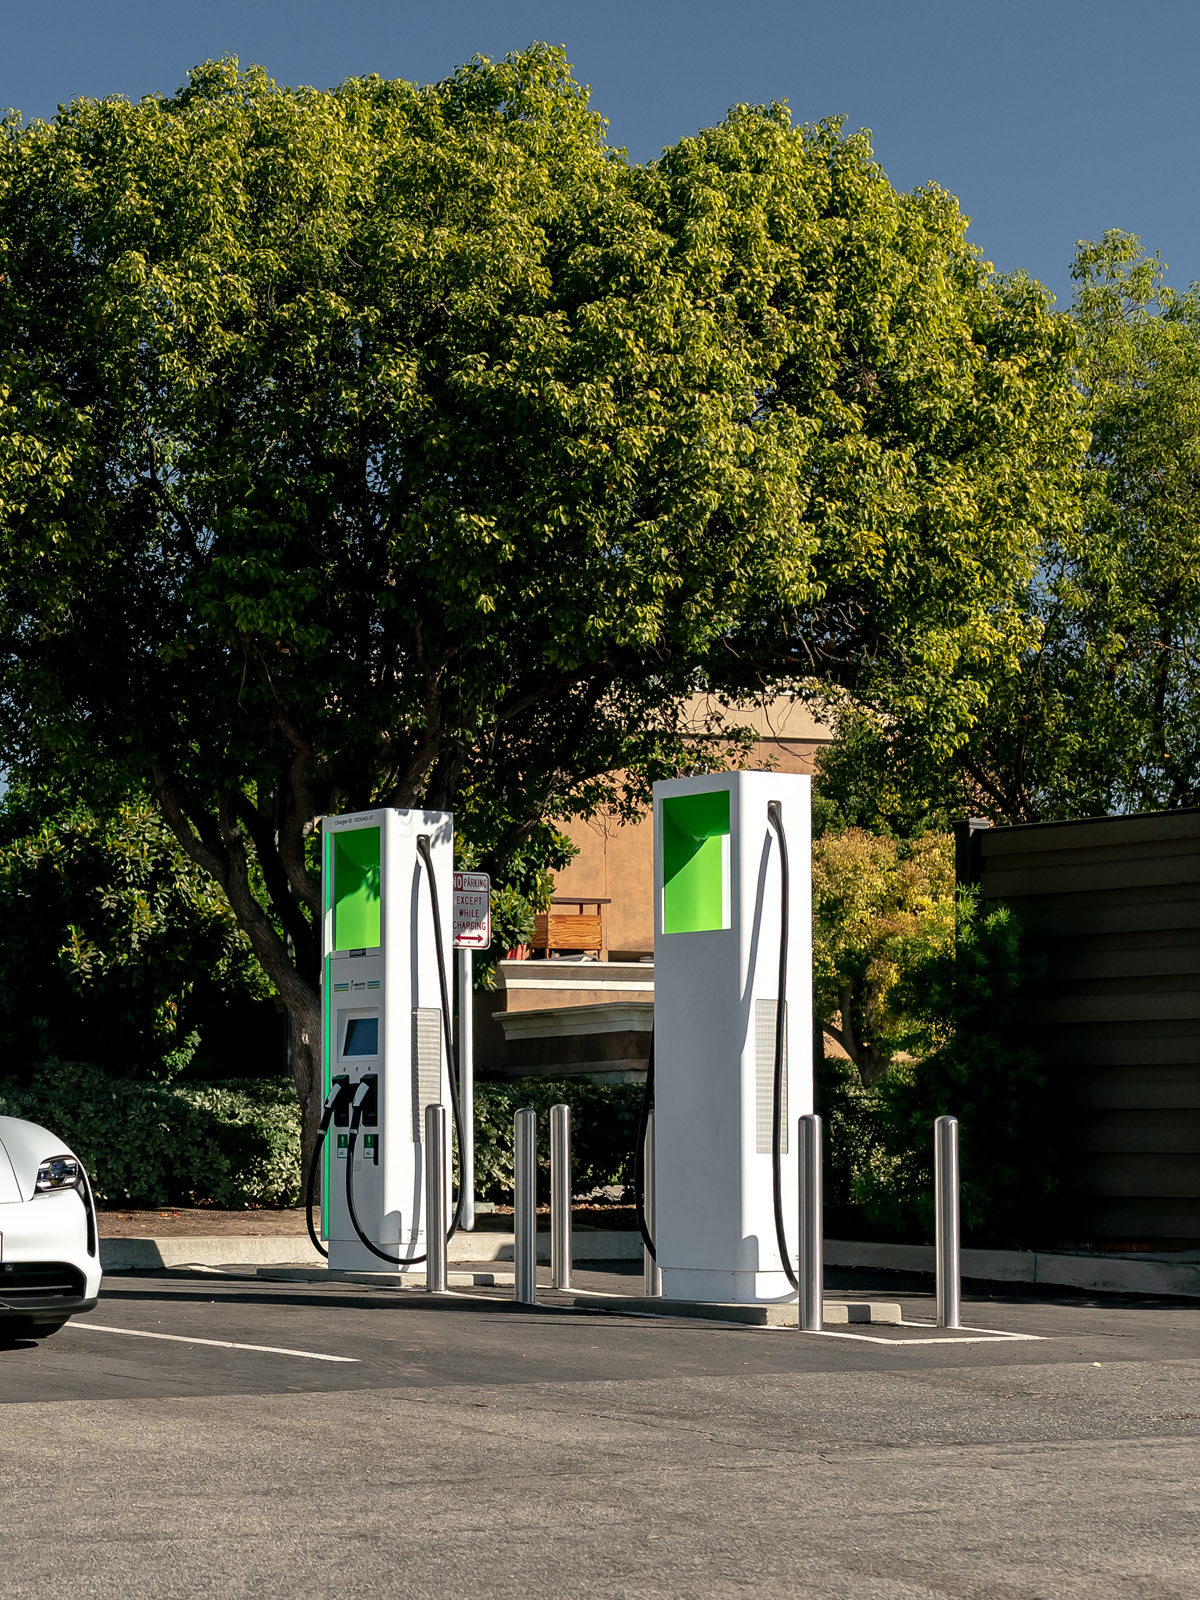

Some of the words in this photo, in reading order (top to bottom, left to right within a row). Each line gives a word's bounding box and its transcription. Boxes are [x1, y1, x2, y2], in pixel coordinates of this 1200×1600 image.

[463, 877, 487, 889] PARKING
[456, 895, 482, 906] EXCEPT
[459, 908, 479, 918] WHILE
[453, 920, 486, 931] CHARGING
